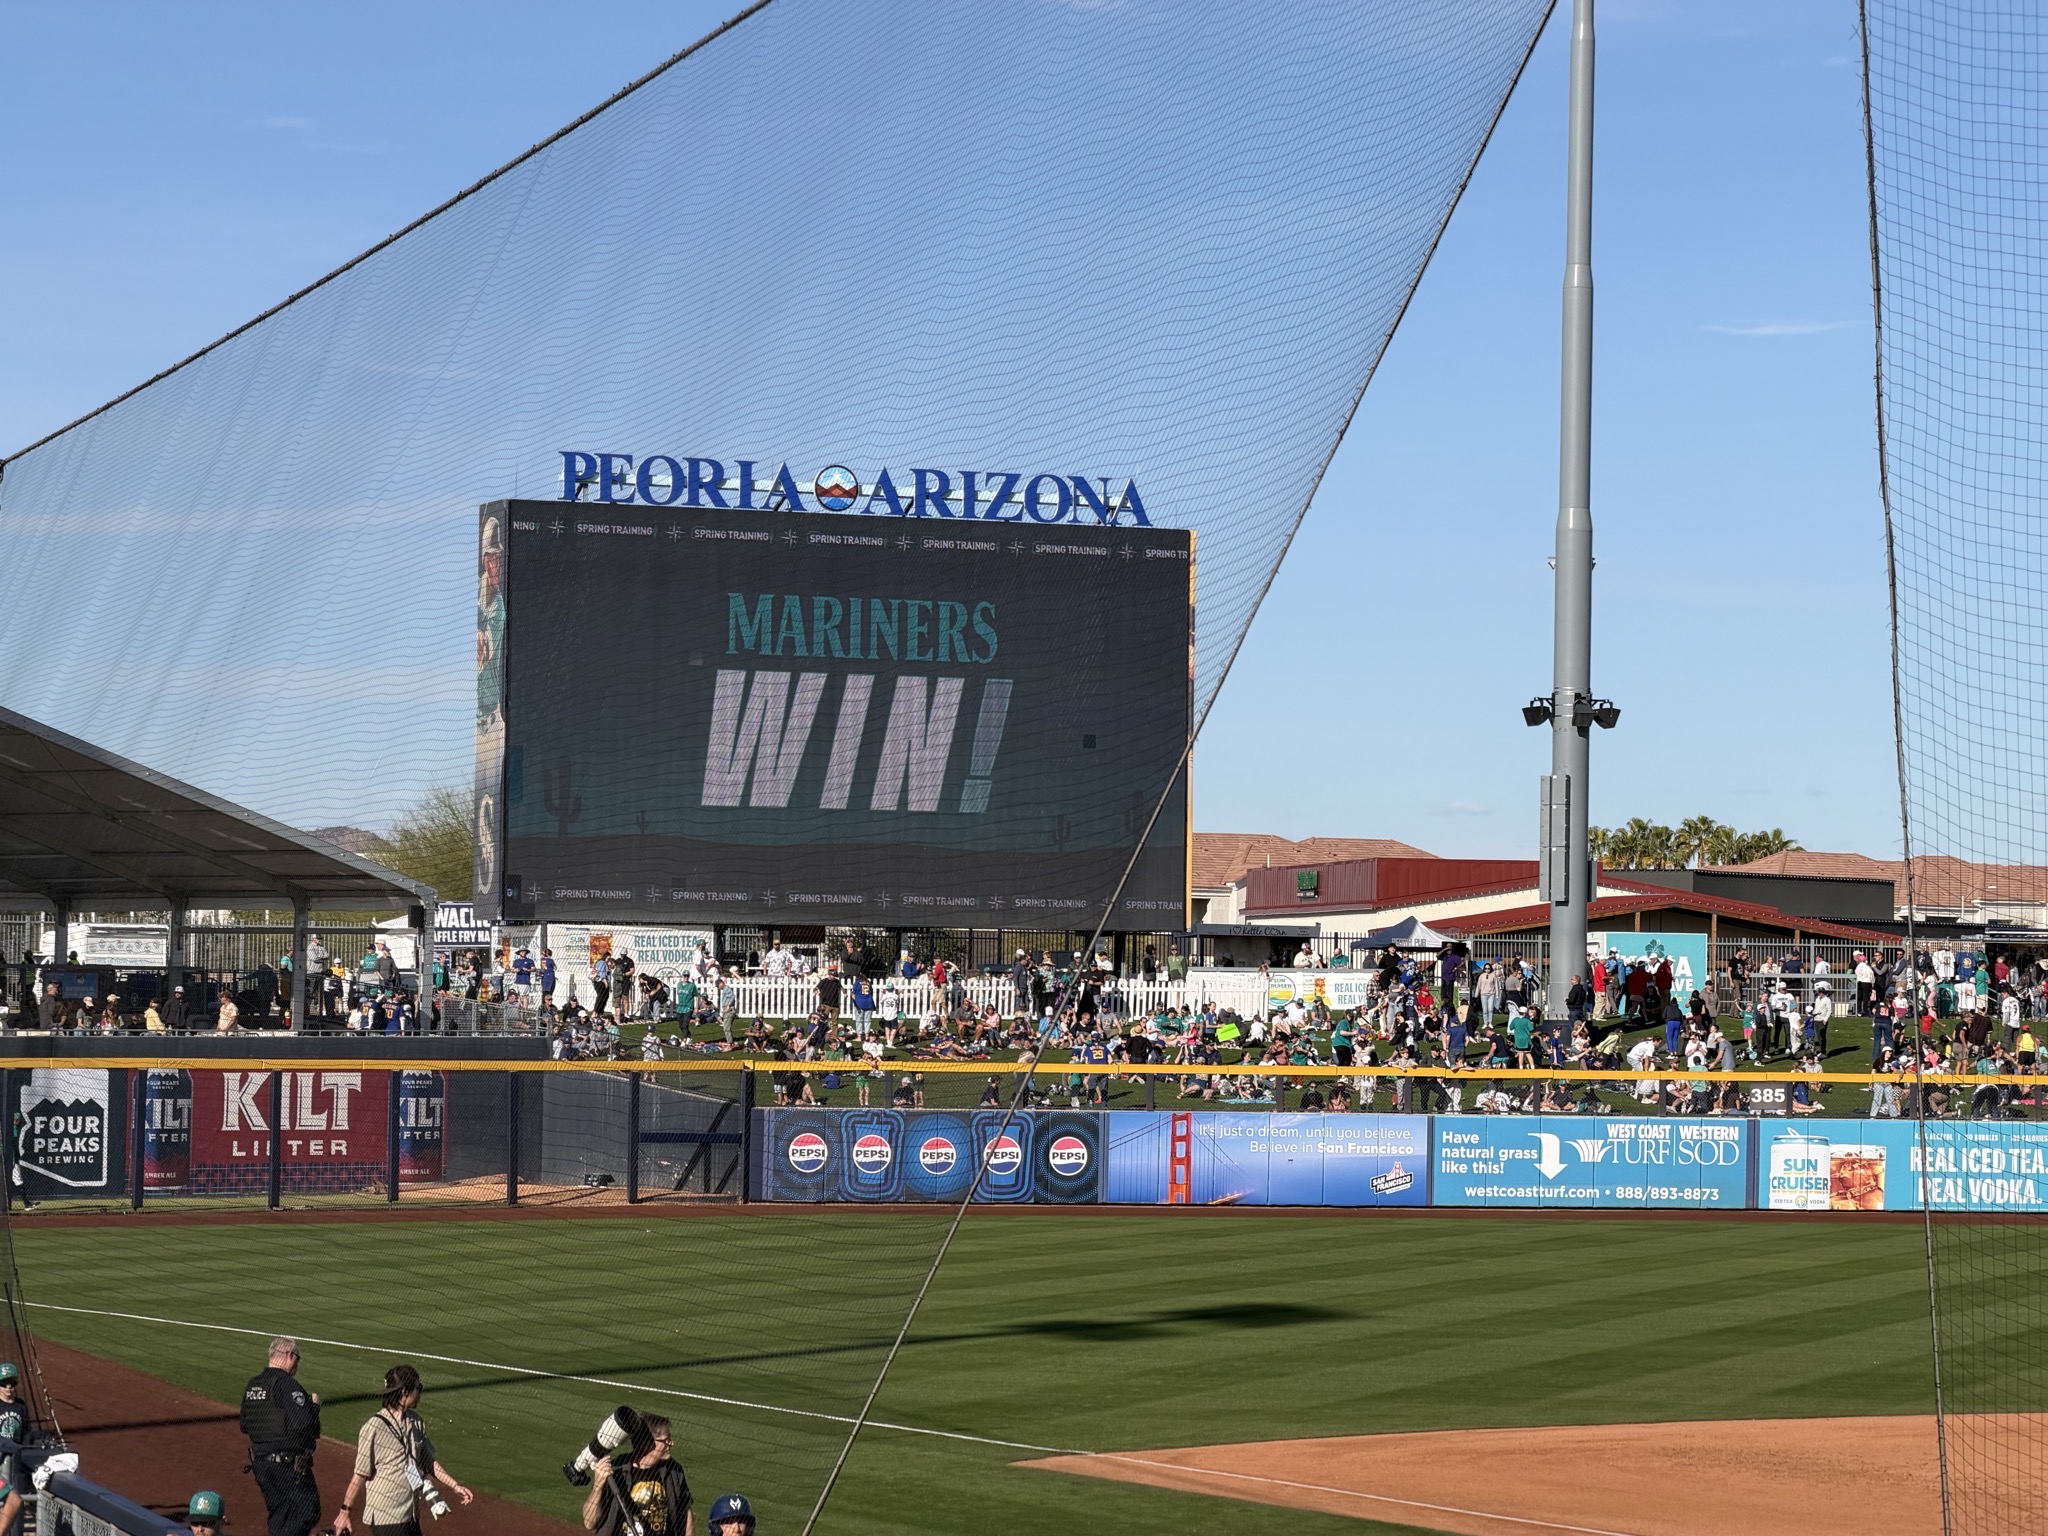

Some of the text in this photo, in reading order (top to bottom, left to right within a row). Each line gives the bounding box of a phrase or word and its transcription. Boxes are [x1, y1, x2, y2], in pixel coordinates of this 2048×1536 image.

[558, 451, 1153, 527] PEORIA ARIZONA
[576, 524, 609, 534] SPRING
[611, 525, 653, 536] TRAINING
[694, 529, 727, 540] SPRING
[728, 531, 769, 541] TRAINING
[809, 534, 841, 544] SPRING
[843, 536, 884, 546] TRAINING
[923, 539, 955, 549] SPRING
[957, 541, 996, 552] TRAINING
[1035, 544, 1066, 555] SPRING
[1068, 546, 1107, 557] TRAINING
[1145, 549, 1176, 559] SPRING
[726, 592, 998, 664] MARINERS
[701, 669, 1014, 813] WIN!
[555, 889, 588, 900] SPRING
[590, 889, 632, 900] TRAINING
[672, 890, 705, 901] SPRING
[706, 890, 748, 901] TRAINING
[788, 892, 820, 903] SPRING
[822, 894, 862, 905] TRAINING
[902, 896, 934, 906] SPRING
[936, 896, 976, 907] TRAINING
[1015, 898, 1046, 908] SPRING
[1047, 898, 1087, 909] TRAINING
[1126, 900, 1156, 910] SPRING
[458, 930, 476, 943] FRY
[1242, 926, 1262, 936] Kettle
[634, 935, 656, 947] REAL
[659, 935, 679, 947] ICED
[1414, 938, 1427, 947] PUB
[638, 950, 693, 962] REAL VODKA
[1334, 983, 1367, 993] REAL ICE
[1338, 995, 1357, 1005] REAL
[1093, 1049, 1103, 1059] 29
[221, 1071, 362, 1131] KILT
[1751, 1088, 1785, 1103] 385
[34, 1115, 100, 1135] FOUR
[1607, 1123, 1739, 1141] WEST COAST WESTERN
[148, 1133, 188, 1143] FTER
[403, 1131, 441, 1140] FTER
[1199, 1125, 1413, 1140] It's just a dream, until you believe.
[1442, 1131, 1479, 1144] Have
[34, 1137, 100, 1154] PEAKS
[232, 1139, 348, 1157] LITER
[791, 1148, 825, 1157] PEPSI
[1250, 1141, 1414, 1155] Believe in San Francisco
[1607, 1138, 1740, 1166] TURF SOD
[38, 1155, 95, 1164] BREWING
[855, 1149, 889, 1158] PEPSI
[922, 1151, 954, 1160] PEPSI
[1052, 1152, 1085, 1160] PEPSI
[1442, 1146, 1538, 1161] natural grass
[1910, 1146, 1958, 1172] REAL
[1962, 1148, 2006, 1173] ICED
[1442, 1161, 1504, 1174] like this!
[1783, 1158, 1818, 1172] SUN
[1372, 1176, 1385, 1186] SAN
[1377, 1175, 1411, 1192] FRANCISCO
[1772, 1176, 1829, 1190] CRUISER
[1465, 1185, 1719, 1201] westcoastturf.com 888/893-8873
[1918, 1177, 2043, 1204] REAL VODKA.
[246, 1391, 267, 1400] POLICE
